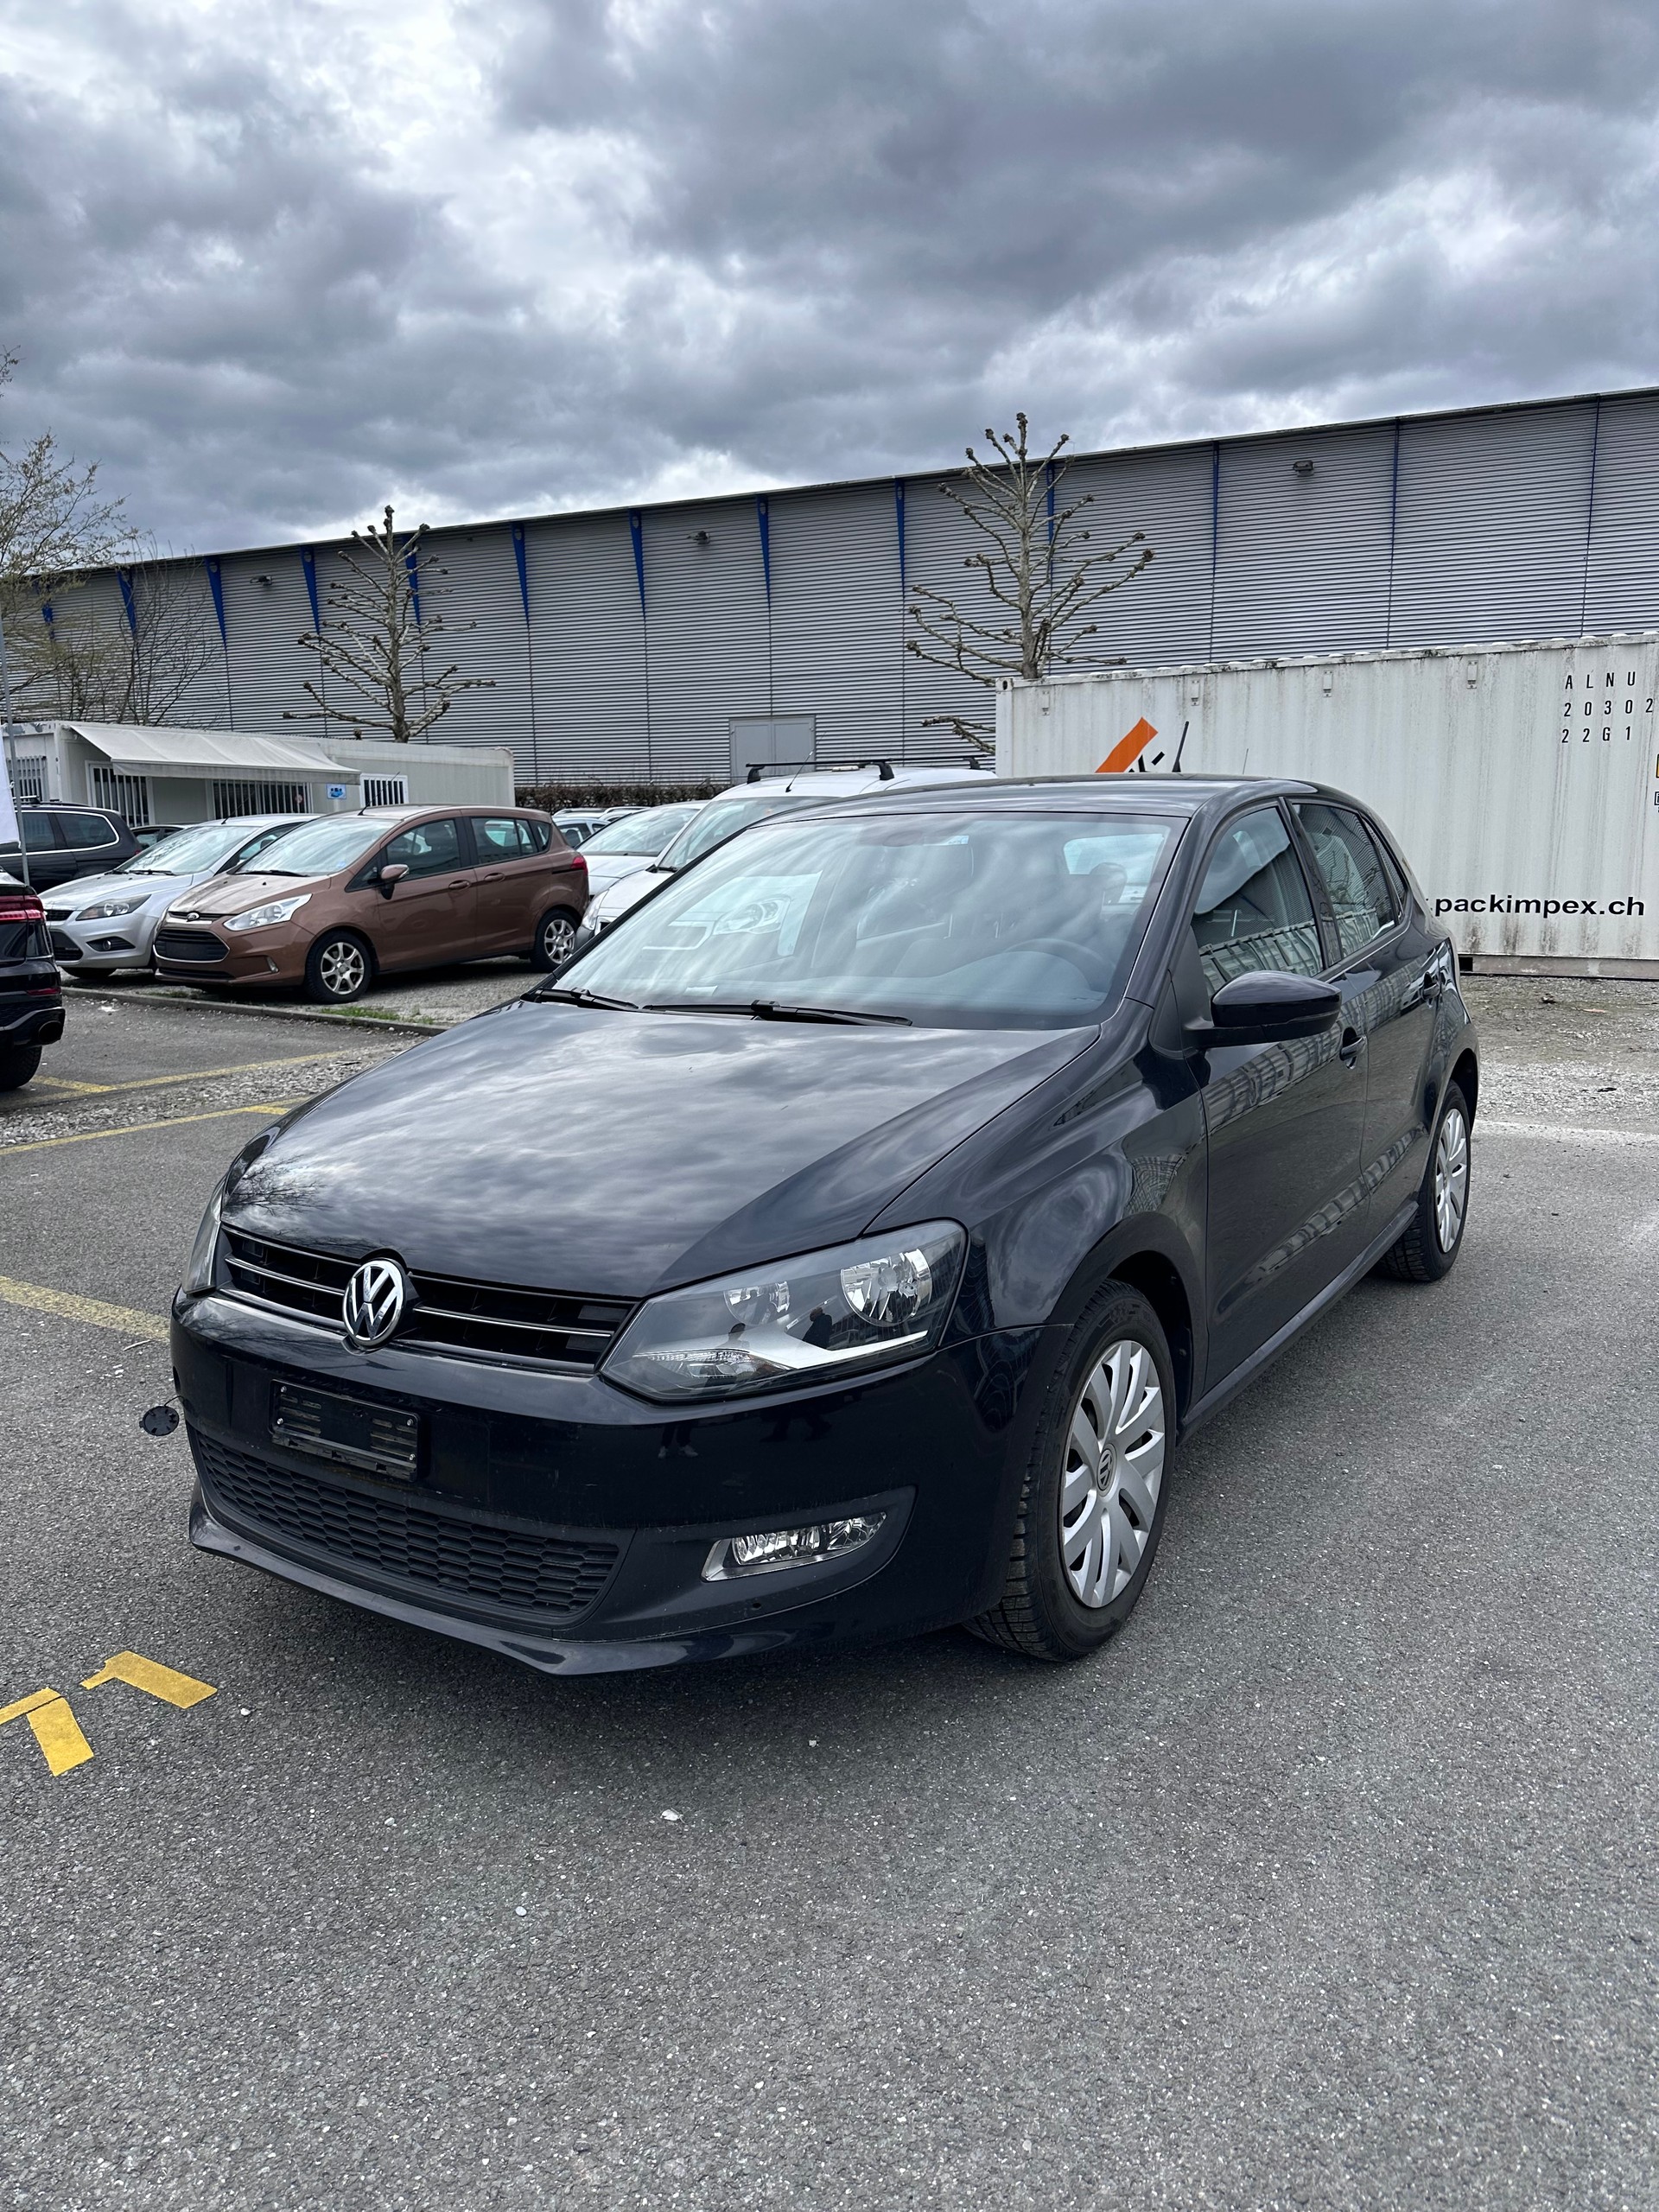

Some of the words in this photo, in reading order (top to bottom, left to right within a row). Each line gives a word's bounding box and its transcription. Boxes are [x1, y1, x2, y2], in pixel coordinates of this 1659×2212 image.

[1565, 671, 1636, 690] ALNU
[1562, 726, 1630, 743] 22G1
[1426, 894, 1645, 918] packimpex.ch
[345, 1261, 402, 1343] VW
